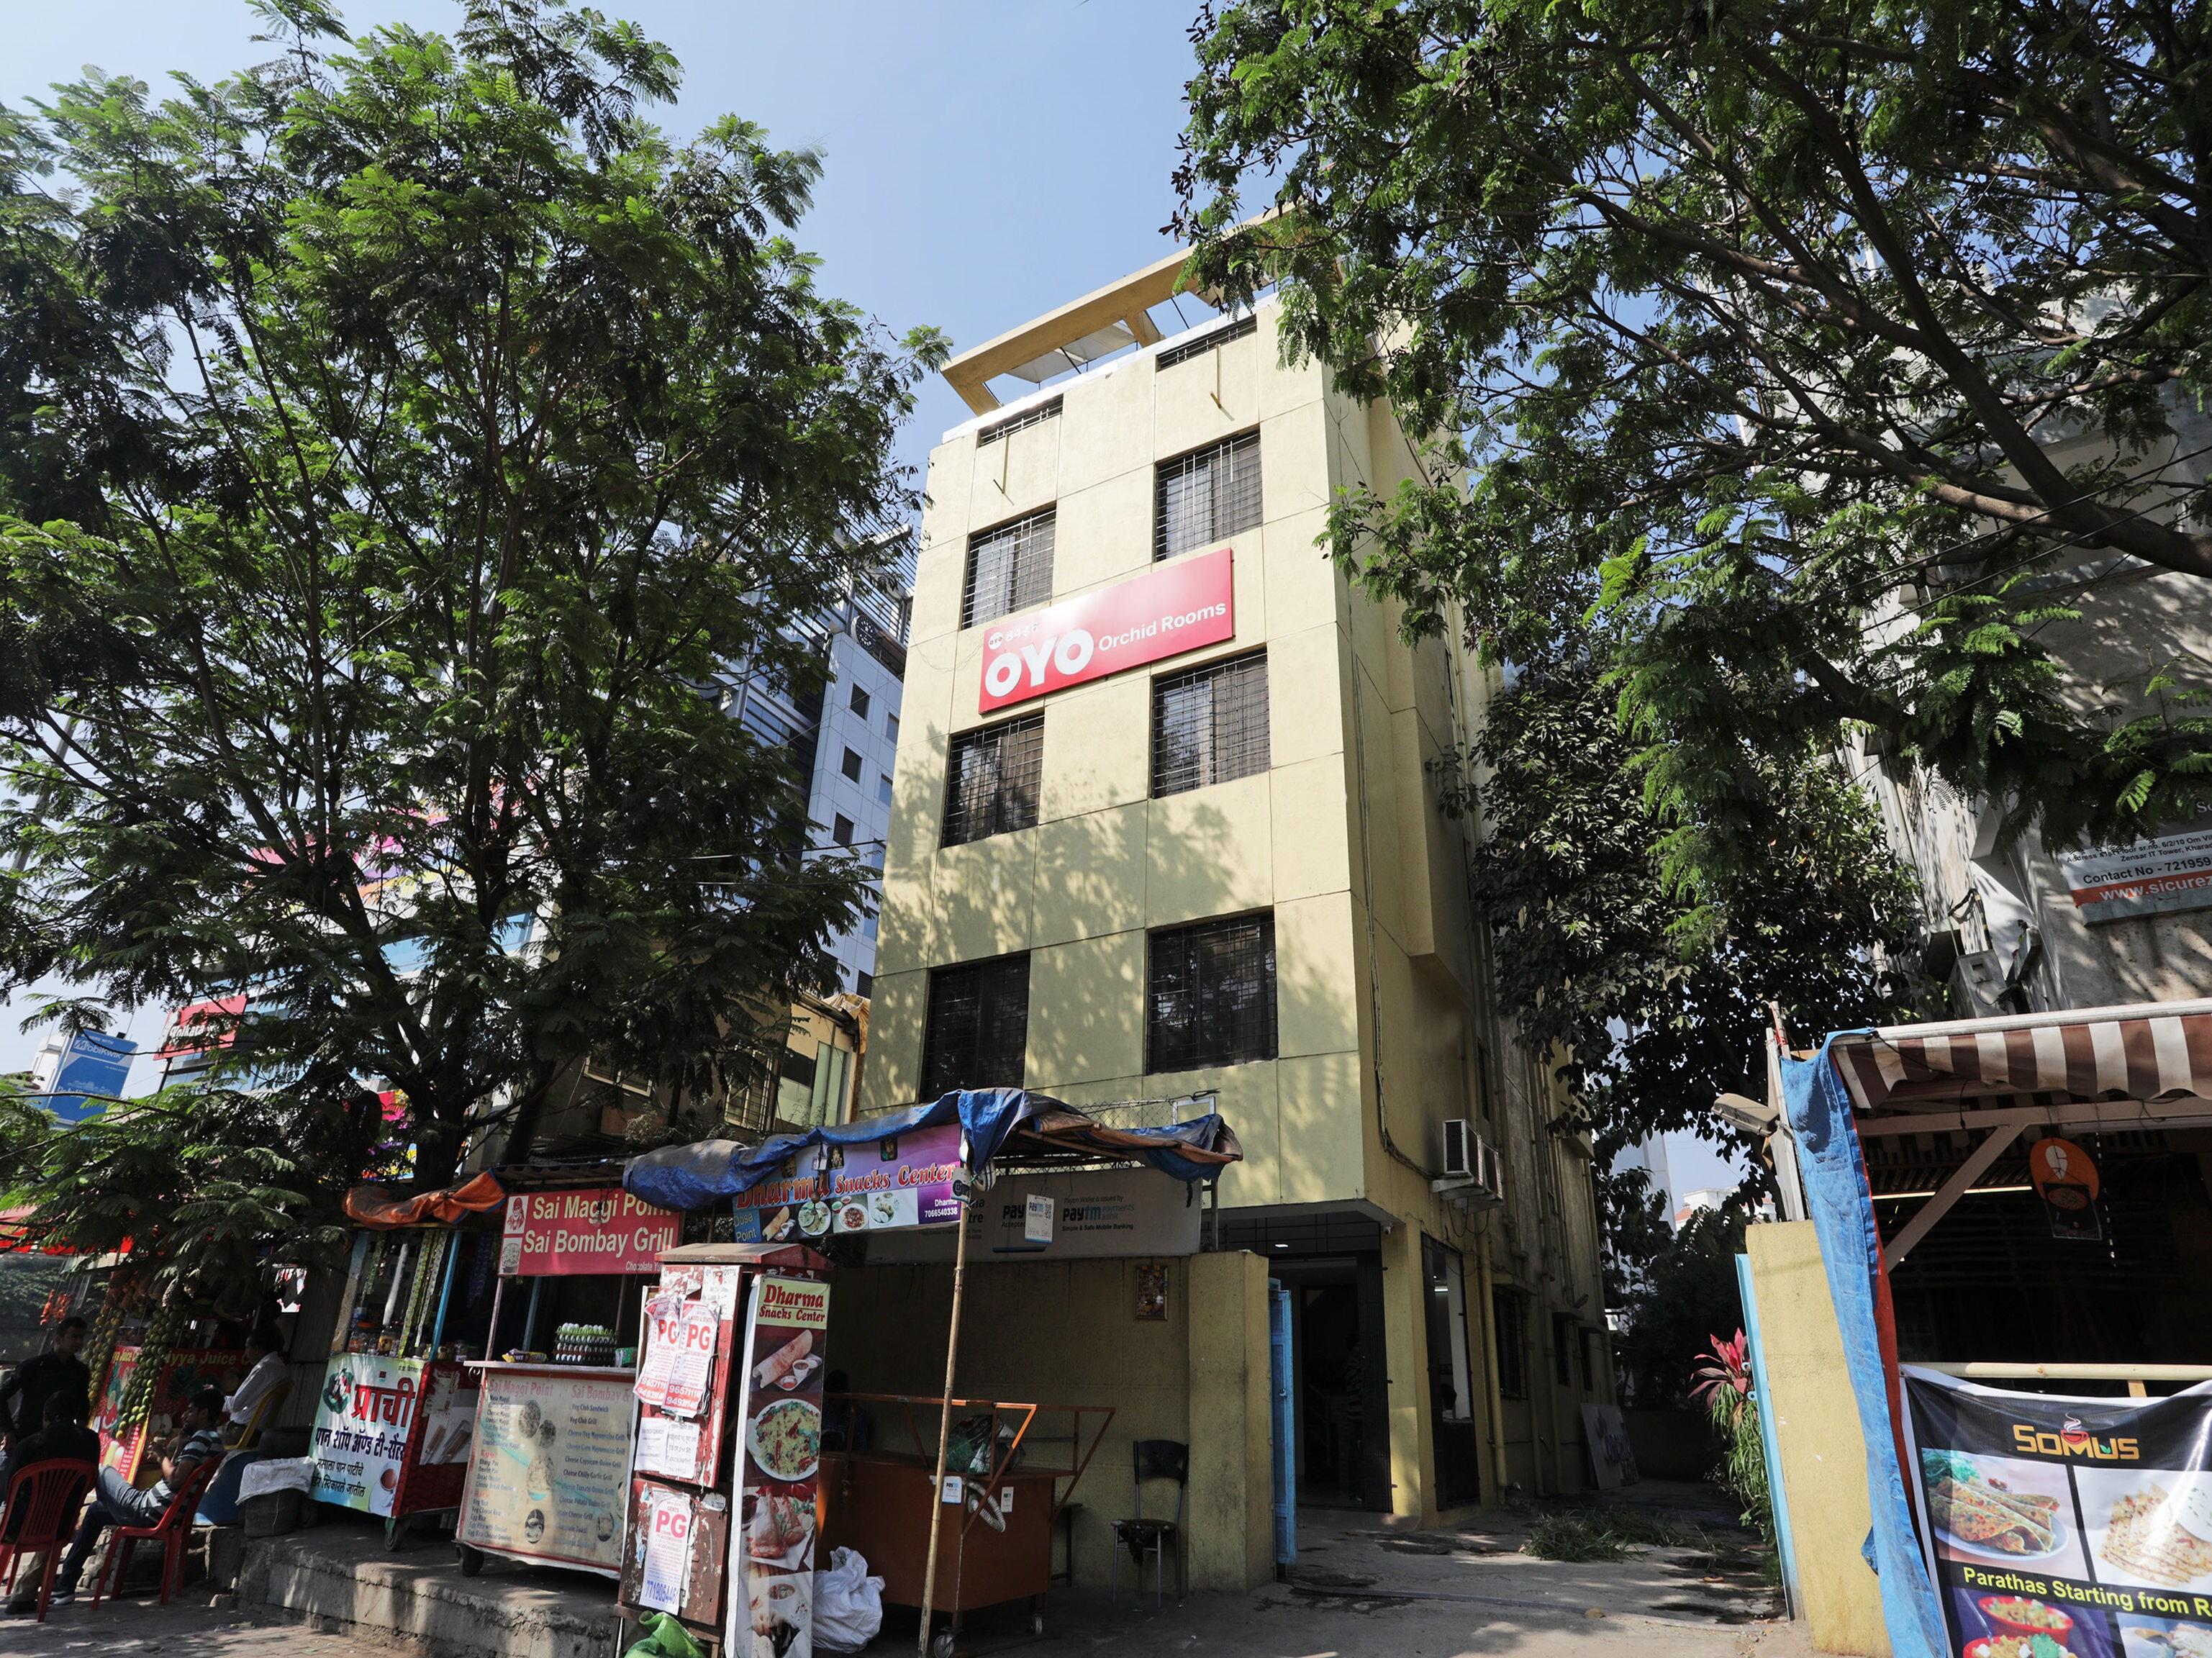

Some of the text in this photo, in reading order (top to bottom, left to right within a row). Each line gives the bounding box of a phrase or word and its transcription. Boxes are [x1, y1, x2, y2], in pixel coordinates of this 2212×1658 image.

[1098, 602, 1226, 651] Orchid Rooms
[989, 636, 1003, 645] OYO
[984, 628, 1094, 697] OYO
[2120, 853, 2147, 862] Zensar
[2083, 869, 2133, 884] Contact
[2134, 866, 2154, 876] No
[2165, 856, 2212, 871] 721959
[835, 1169, 891, 1195] Snacks
[898, 1163, 956, 1187] Center
[533, 1197, 560, 1220] Sai
[564, 1193, 618, 1223] Maggi
[734, 1213, 753, 1228] Dosa
[523, 1227, 674, 1258] Sai Bombay Grill
[736, 1228, 756, 1242] Point
[763, 1285, 824, 1308] Dharma
[759, 1305, 825, 1323] Snacks Center
[658, 1319, 677, 1344] PG
[686, 1323, 711, 1351] PG
[199, 1350, 237, 1365] Juice
[489, 1378, 553, 1397] Sai Maggi Point
[571, 1384, 584, 1398] Sai
[586, 1385, 621, 1401] Bombay
[315, 1427, 332, 1447] पान
[656, 1509, 686, 1539] PG
[1963, 1567, 2048, 1595] Parathas
[2053, 1579, 2134, 1611] Starting
[2138, 1591, 2189, 1616] from
